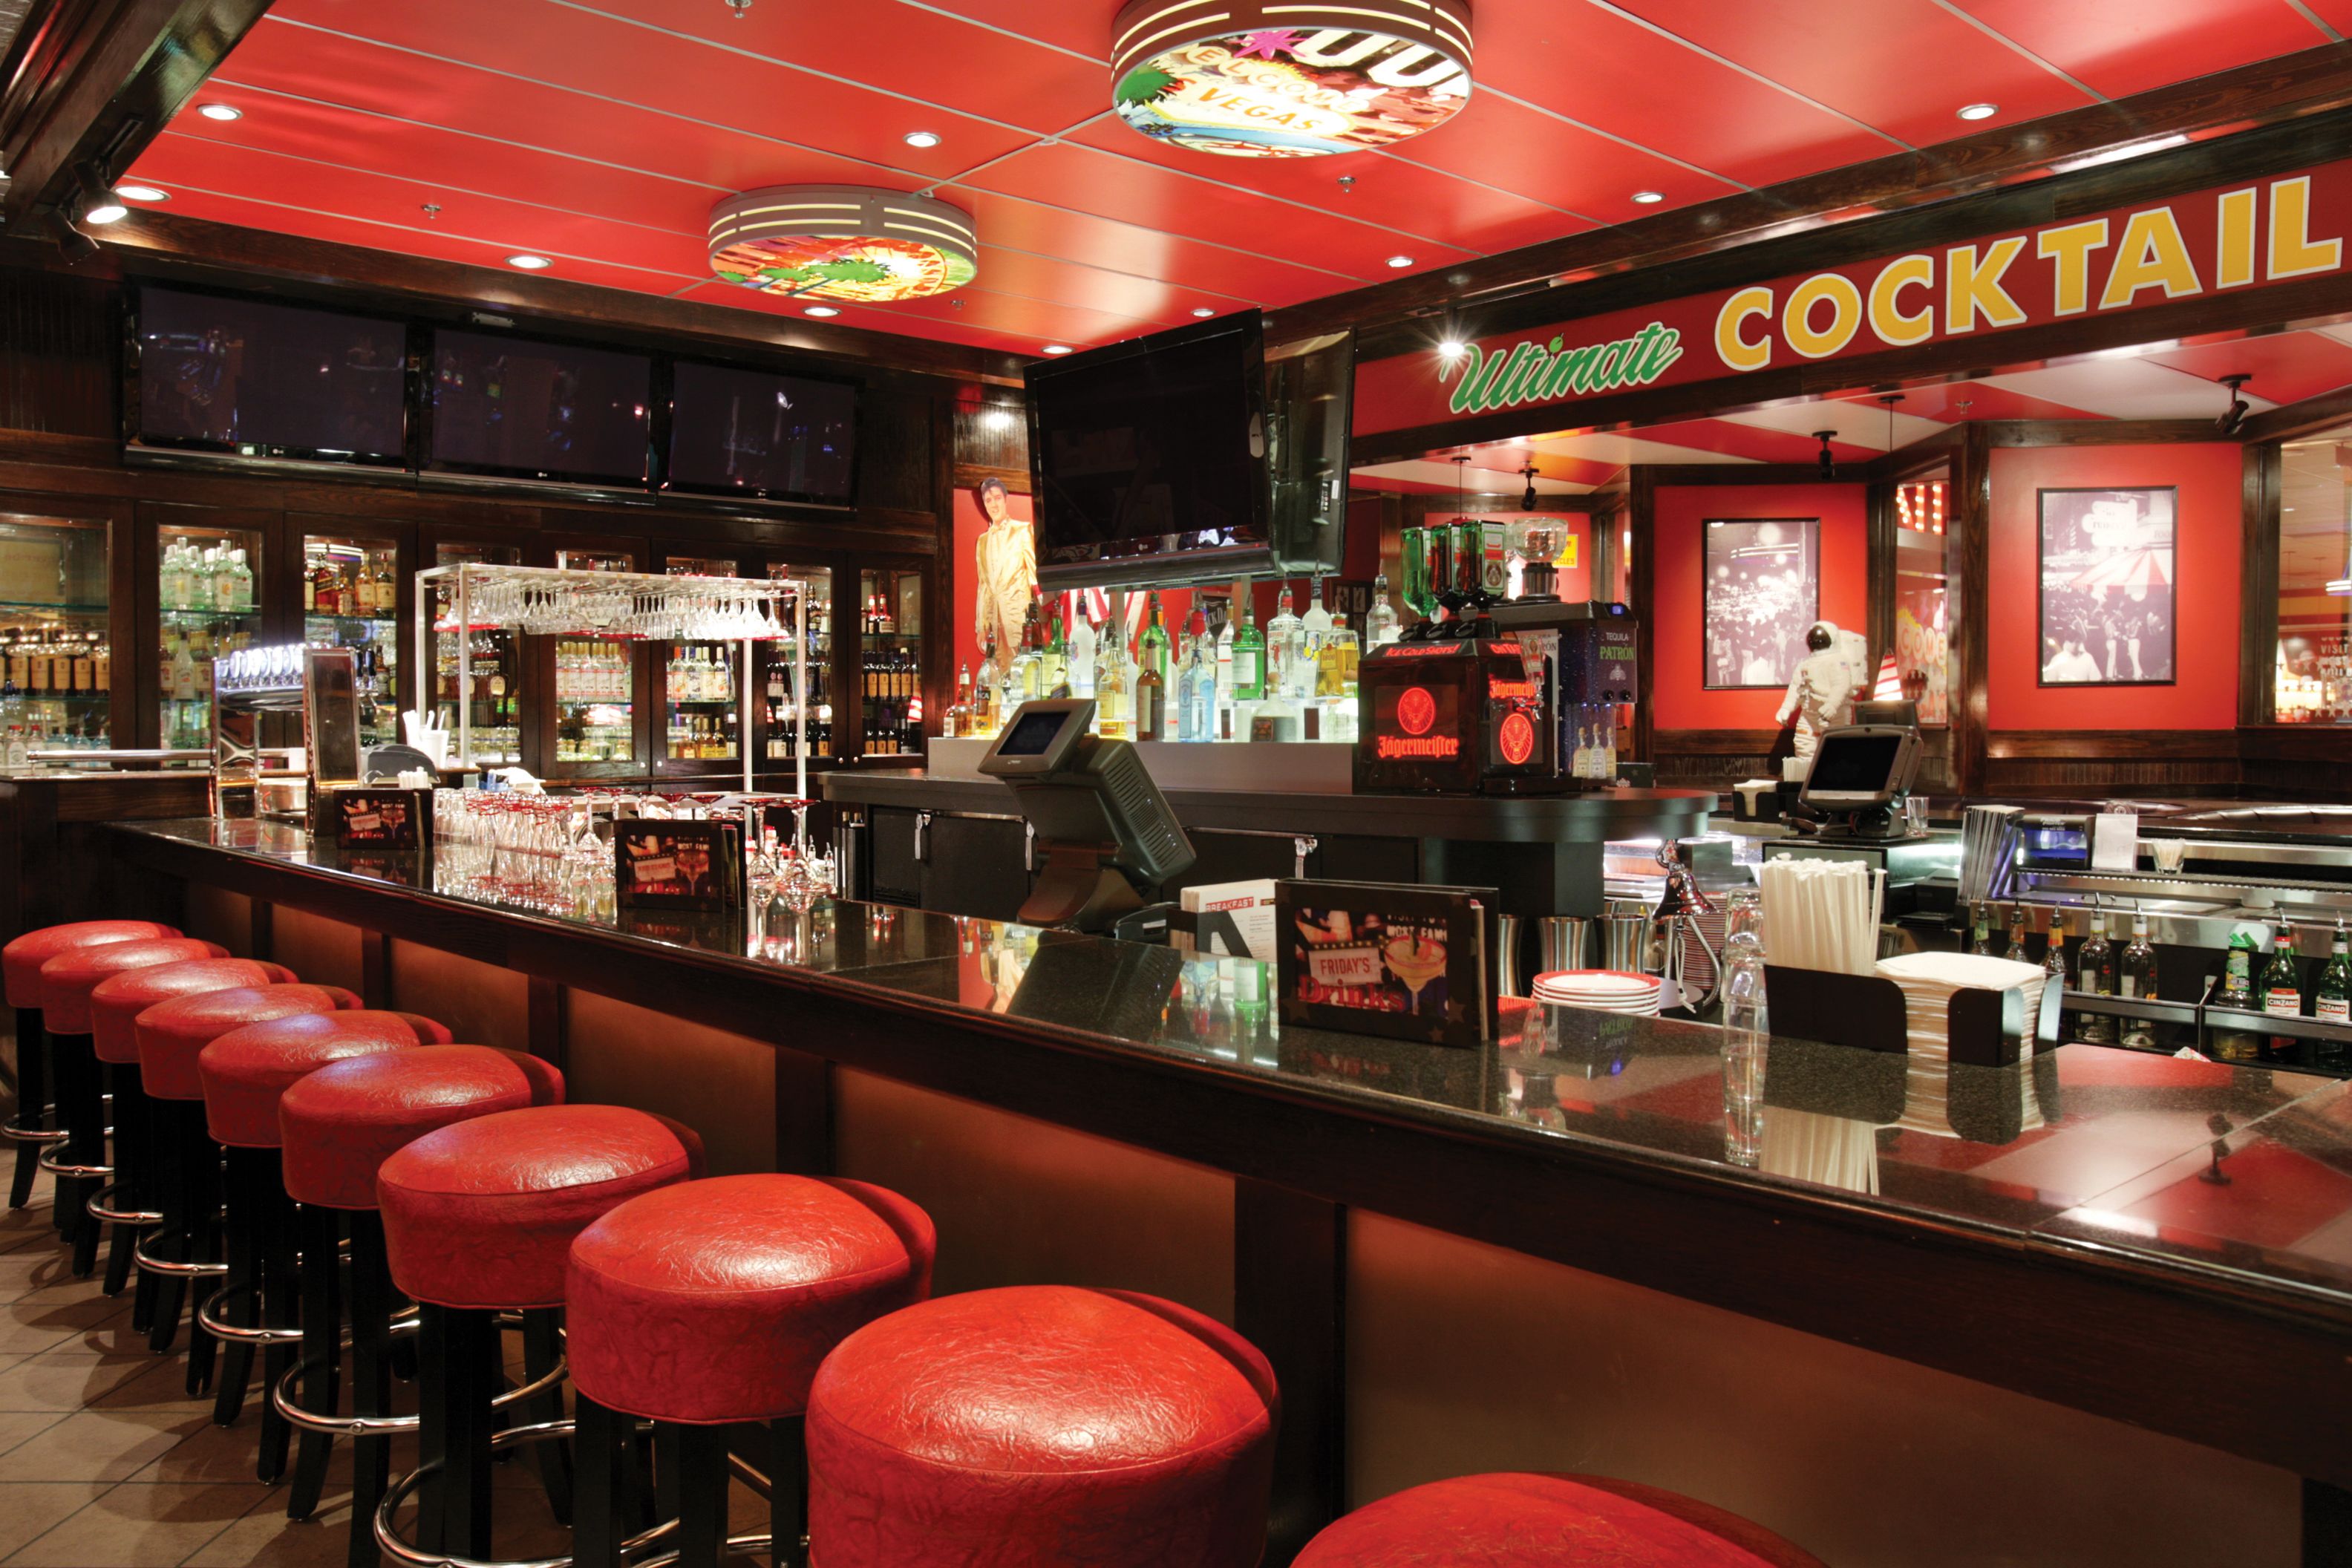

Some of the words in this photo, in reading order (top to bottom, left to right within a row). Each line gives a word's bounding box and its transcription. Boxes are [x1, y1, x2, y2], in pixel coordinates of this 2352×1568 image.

[1194, 48, 1357, 111] ELCOME
[1198, 85, 1322, 131] VEGAS
[1440, 321, 1684, 414] Ultimate
[1714, 175, 2343, 372] COCKTAIL
[1605, 632, 1630, 641] TEQUILA
[1599, 643, 1634, 660] PATRÓN
[2320, 644, 2350, 654] VISIT
[1378, 736, 1460, 758] Jägermeister
[1205, 897, 1254, 912] BREAKFAST
[1320, 957, 1371, 976] FRIDAY'S
[1298, 974, 1405, 1011] Drinks
[2268, 999, 2299, 1007] CINZANO
[2317, 1003, 2346, 1013] CINZANO
